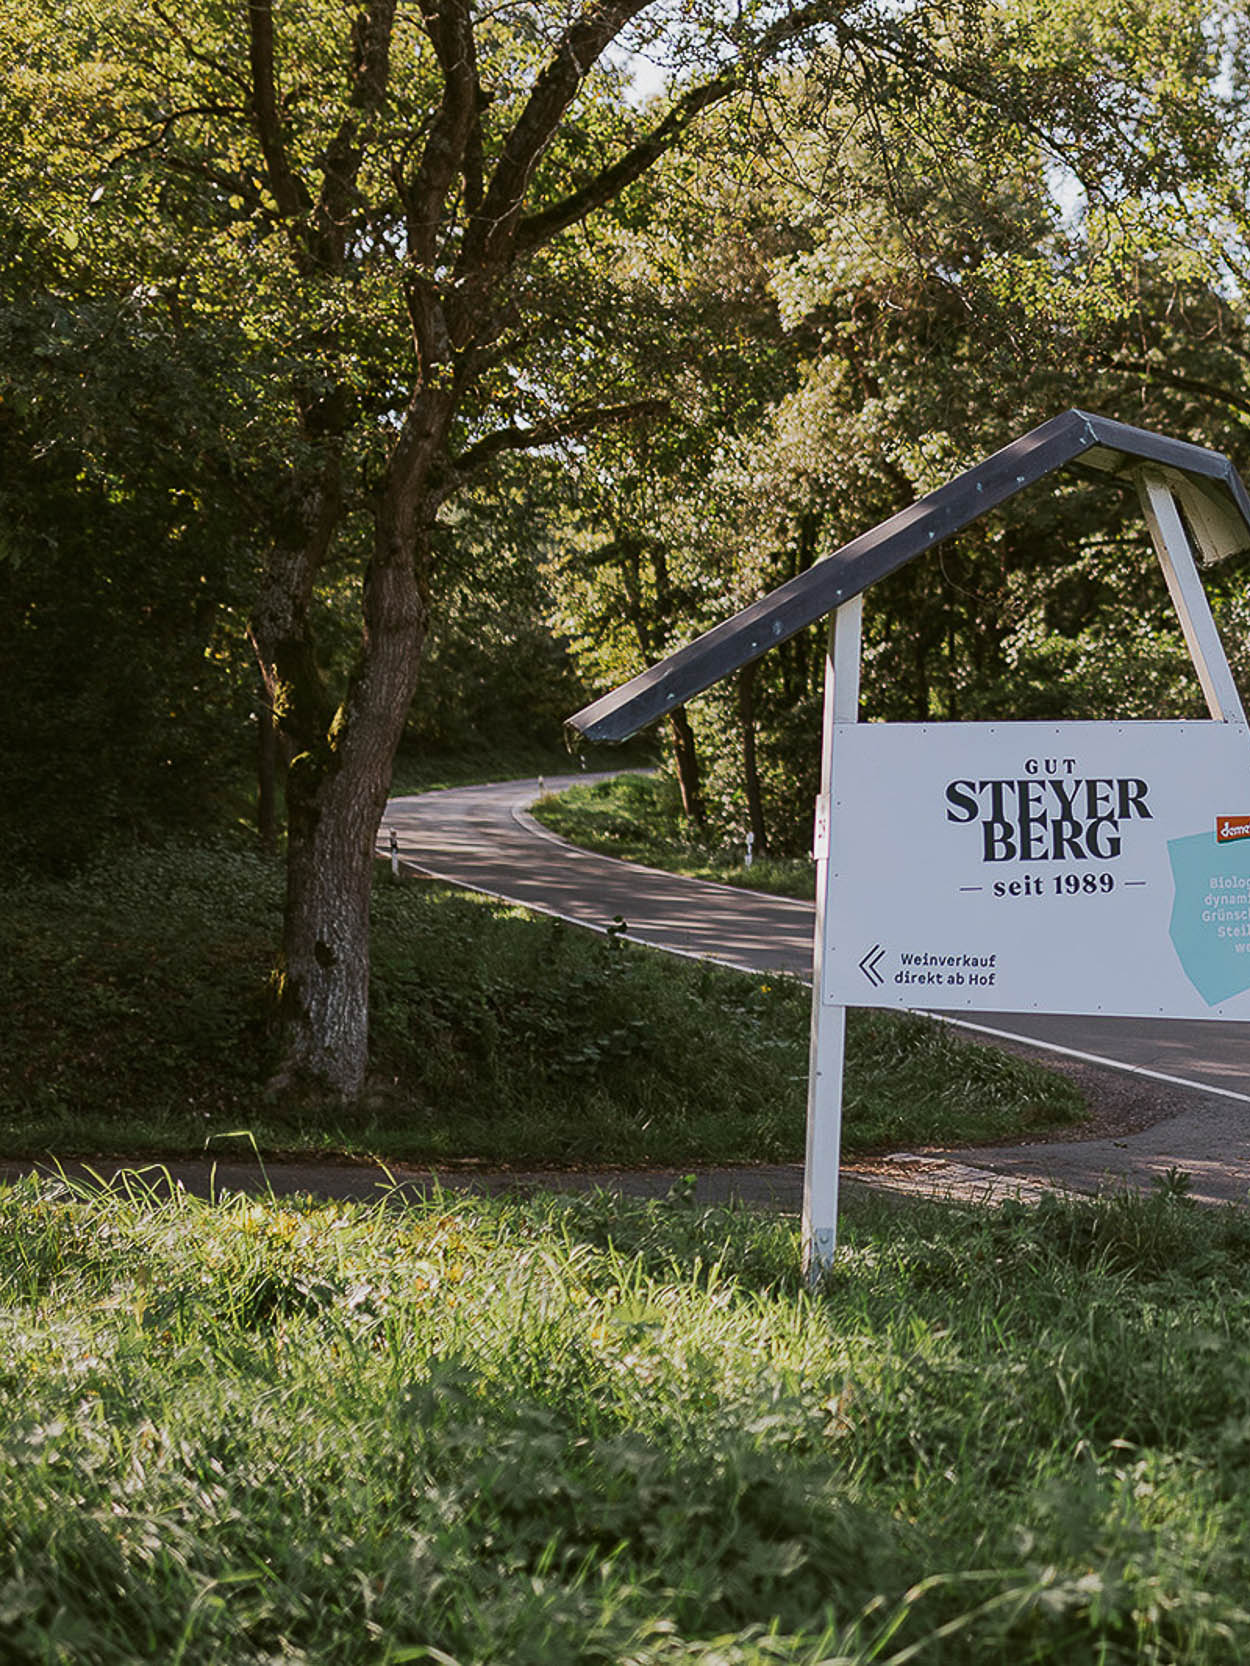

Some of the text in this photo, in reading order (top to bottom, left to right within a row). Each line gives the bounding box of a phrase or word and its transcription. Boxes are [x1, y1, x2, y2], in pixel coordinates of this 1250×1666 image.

[1024, 758, 1076, 775] GUT
[945, 779, 1154, 823] STEYER
[982, 818, 1121, 862] BERG
[993, 872, 1115, 897] seit 1989
[900, 952, 996, 967] Weinverkauf
[894, 970, 996, 986] direkt ab Hof
